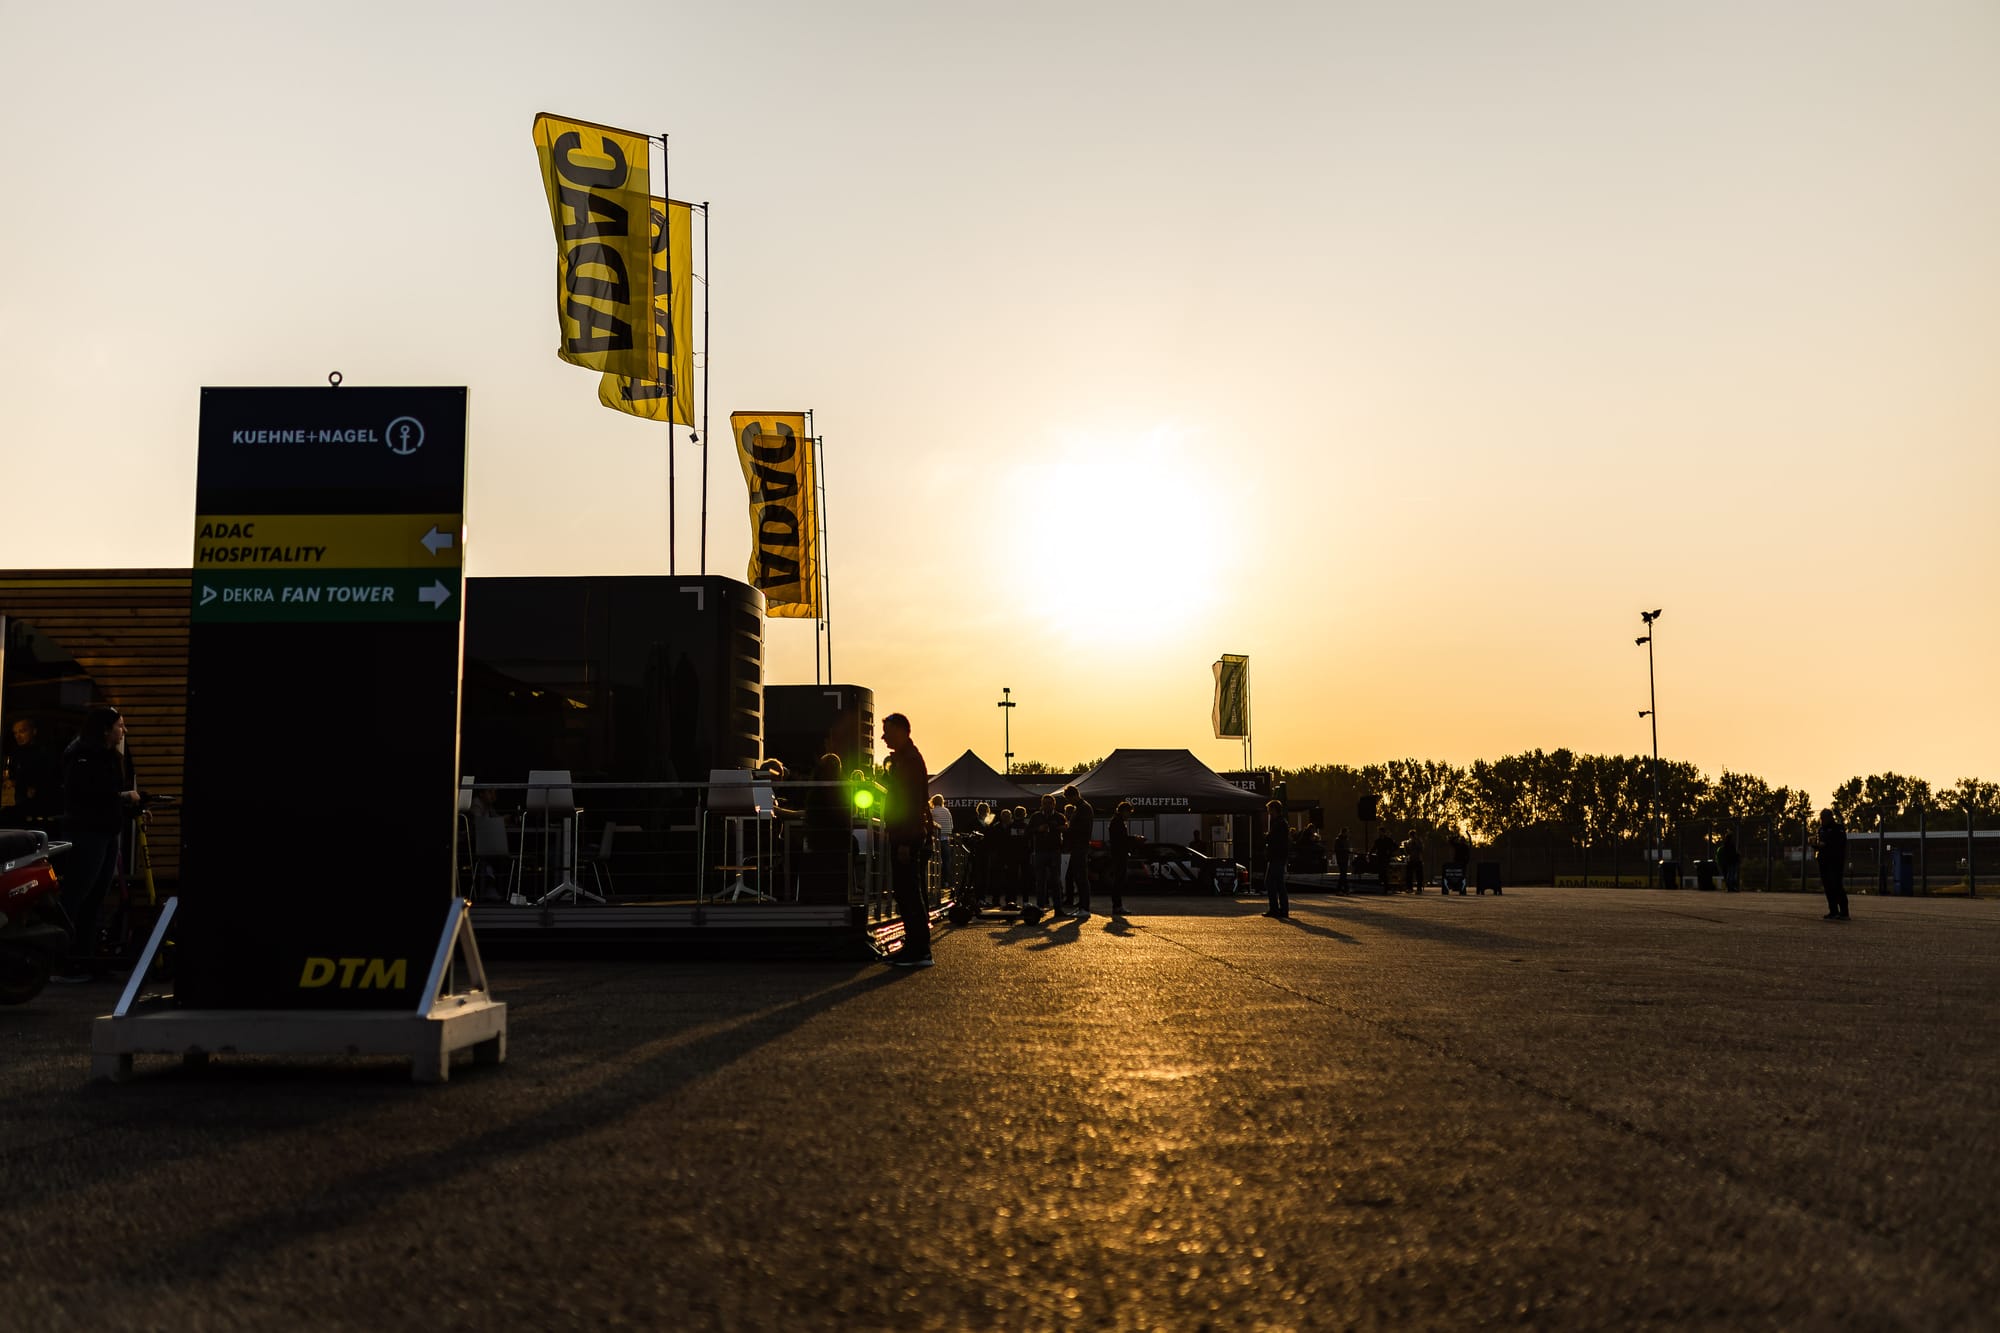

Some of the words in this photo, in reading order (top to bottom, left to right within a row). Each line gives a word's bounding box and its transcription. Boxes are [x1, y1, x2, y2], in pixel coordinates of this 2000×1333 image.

[232, 429, 378, 444] KUEHNE+NAGEL
[199, 523, 255, 538] ADAC
[199, 547, 327, 562] HOSPITALITY
[222, 587, 275, 602] DEKRA
[281, 586, 320, 602] FAN
[326, 586, 395, 602] TOWER
[1125, 797, 1189, 806] SCHAEFFLER
[298, 956, 409, 990] DTM
